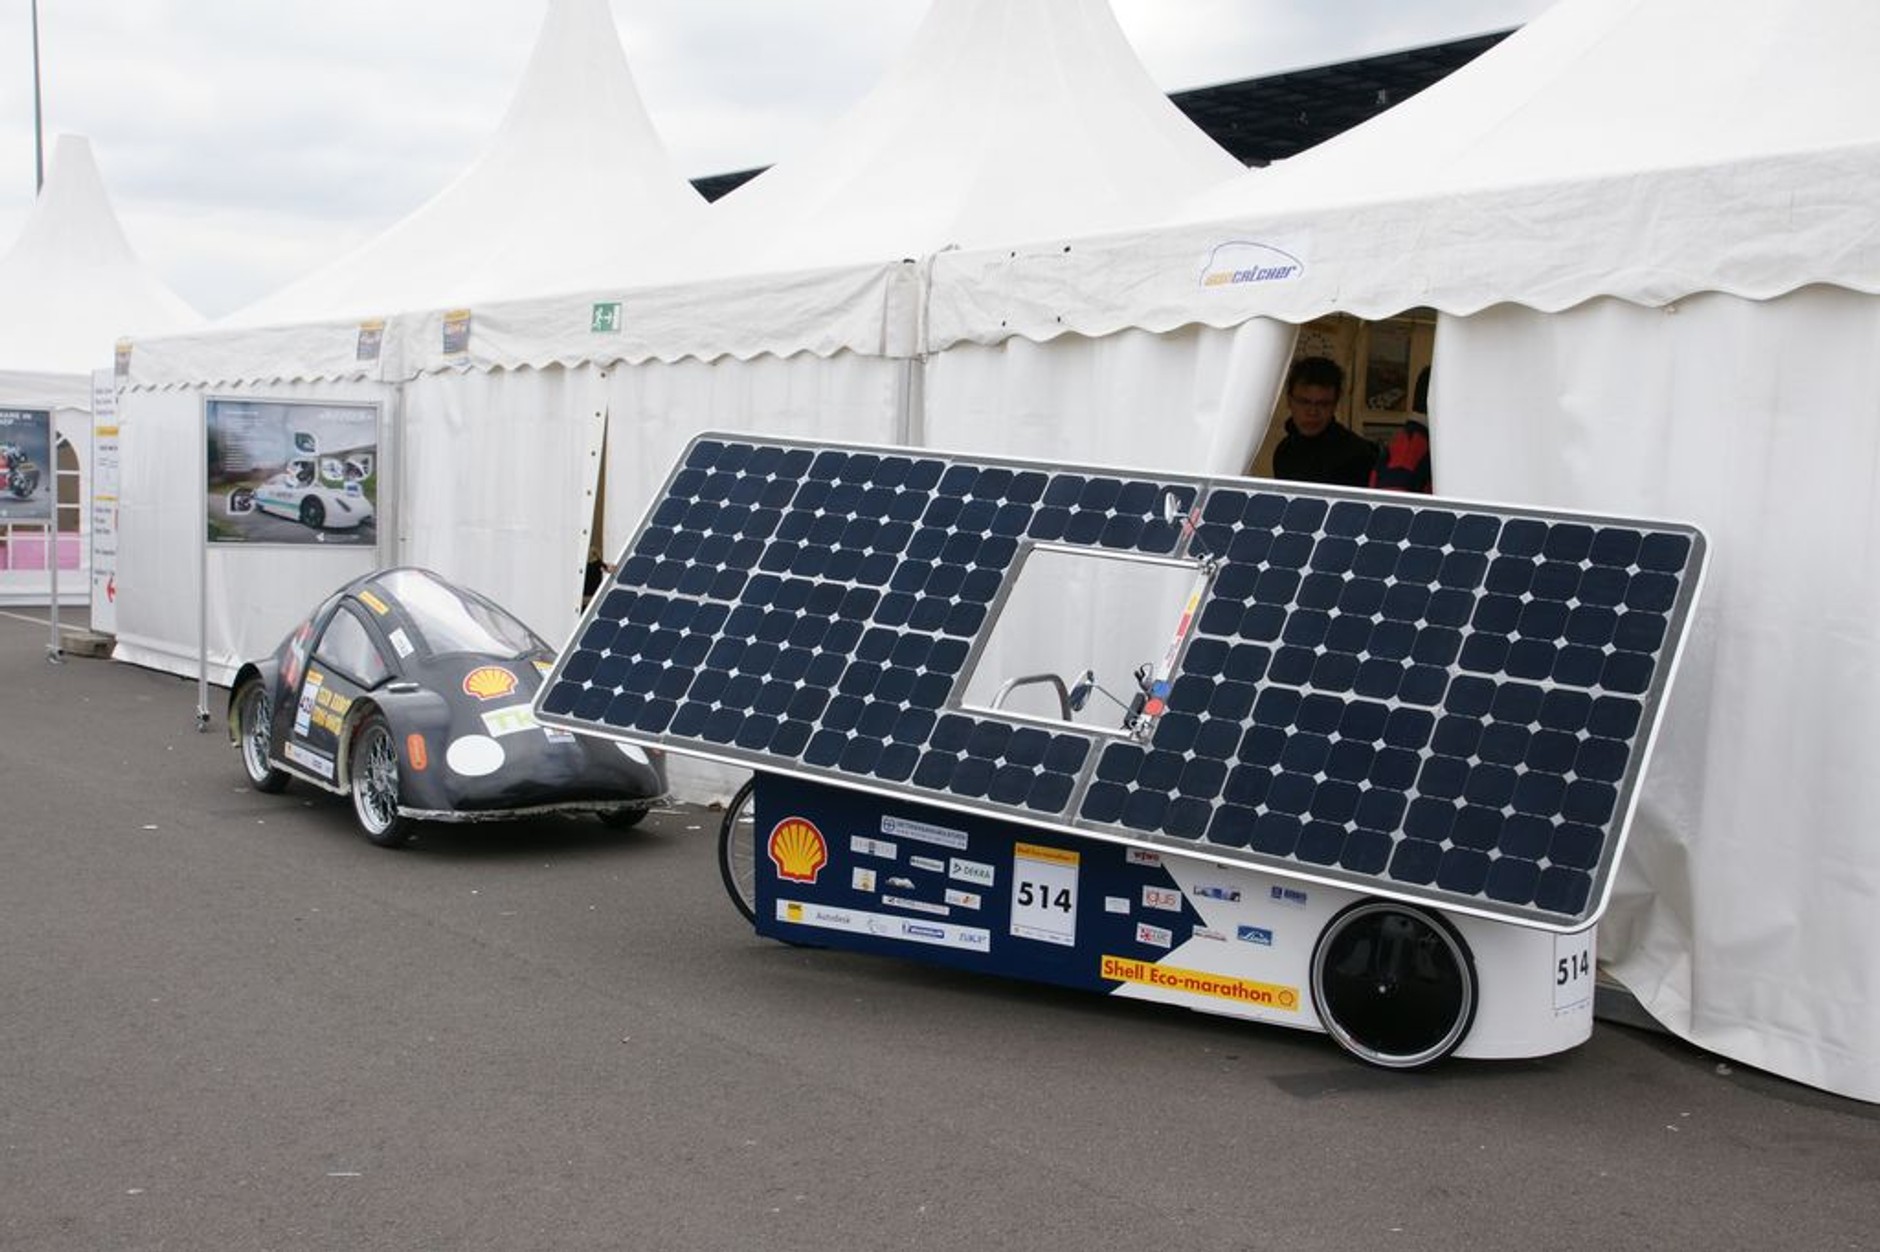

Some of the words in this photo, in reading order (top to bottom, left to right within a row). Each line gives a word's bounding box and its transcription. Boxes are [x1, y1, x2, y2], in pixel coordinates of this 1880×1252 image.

[963, 865, 991, 879] DEKRA
[1017, 881, 1072, 914] 514
[1104, 960, 1144, 980] Shell
[1150, 969, 1273, 1003] Eco-marathon
[1556, 949, 1590, 986] 514
